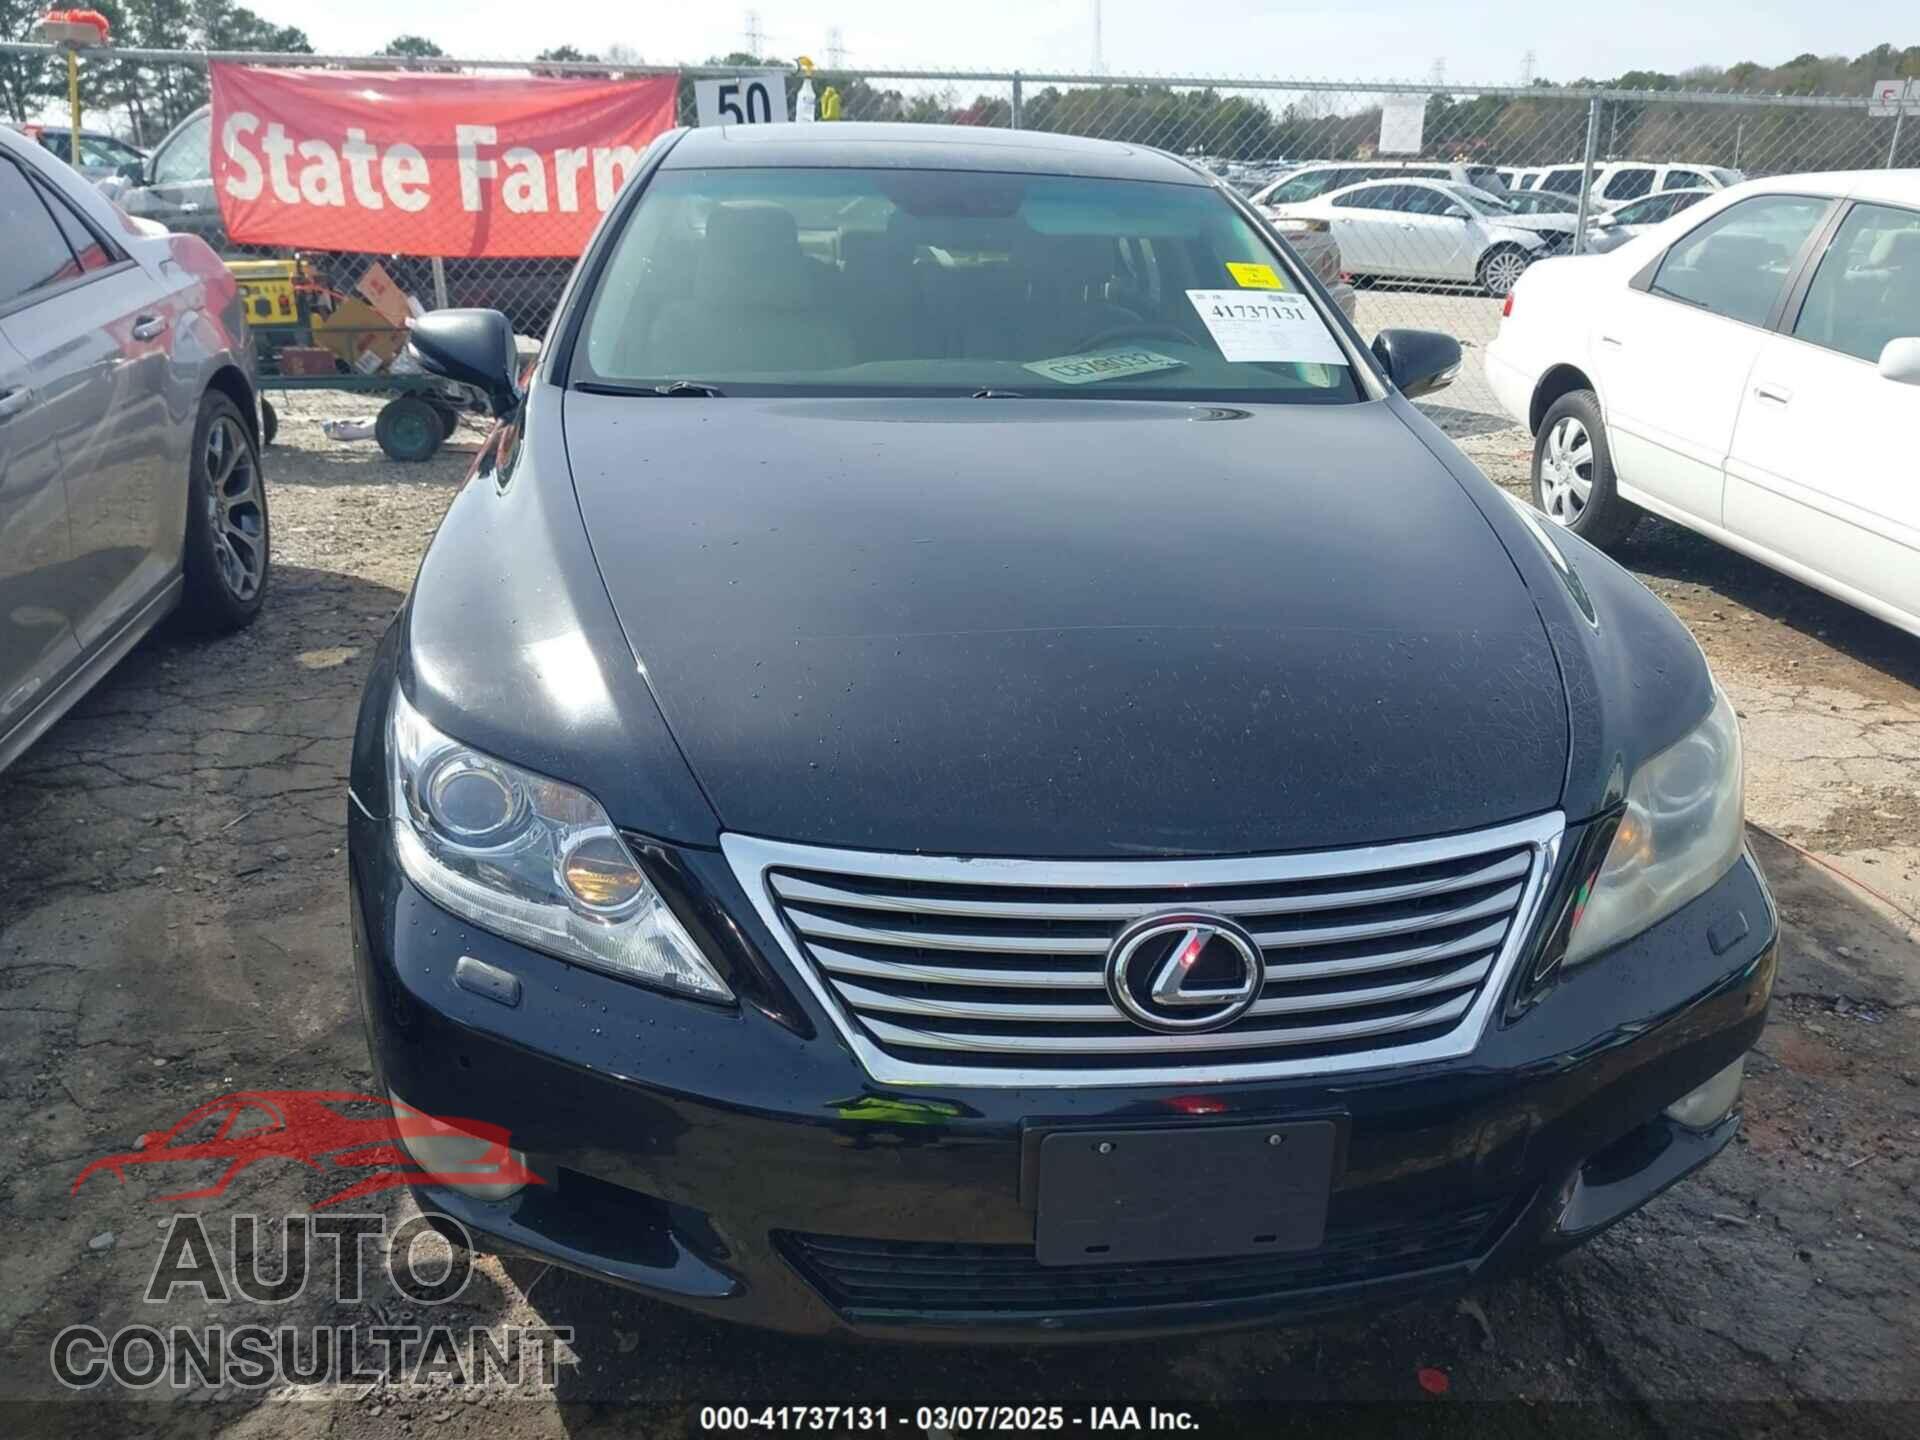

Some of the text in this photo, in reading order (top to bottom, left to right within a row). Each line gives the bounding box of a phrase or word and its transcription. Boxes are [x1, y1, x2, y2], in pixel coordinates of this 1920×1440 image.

[718, 82, 772, 124] 50
[222, 112, 431, 212] State
[1212, 305, 1305, 321] 41737131
